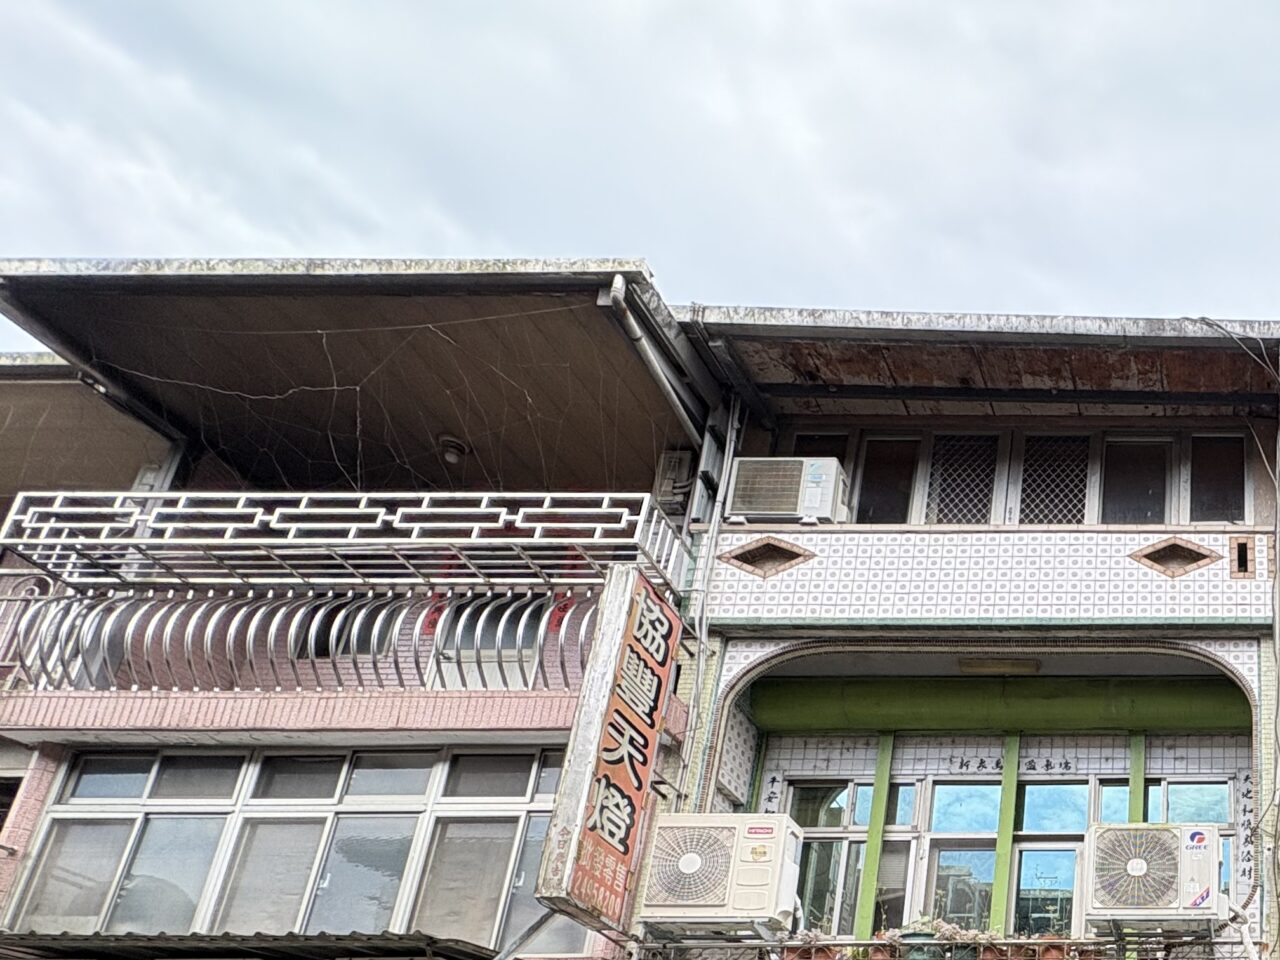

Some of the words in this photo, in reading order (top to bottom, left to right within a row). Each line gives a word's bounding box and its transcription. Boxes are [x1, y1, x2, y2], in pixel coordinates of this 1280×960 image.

[586, 588, 672, 853] 協豐天燈
[765, 775, 781, 813] 平安
